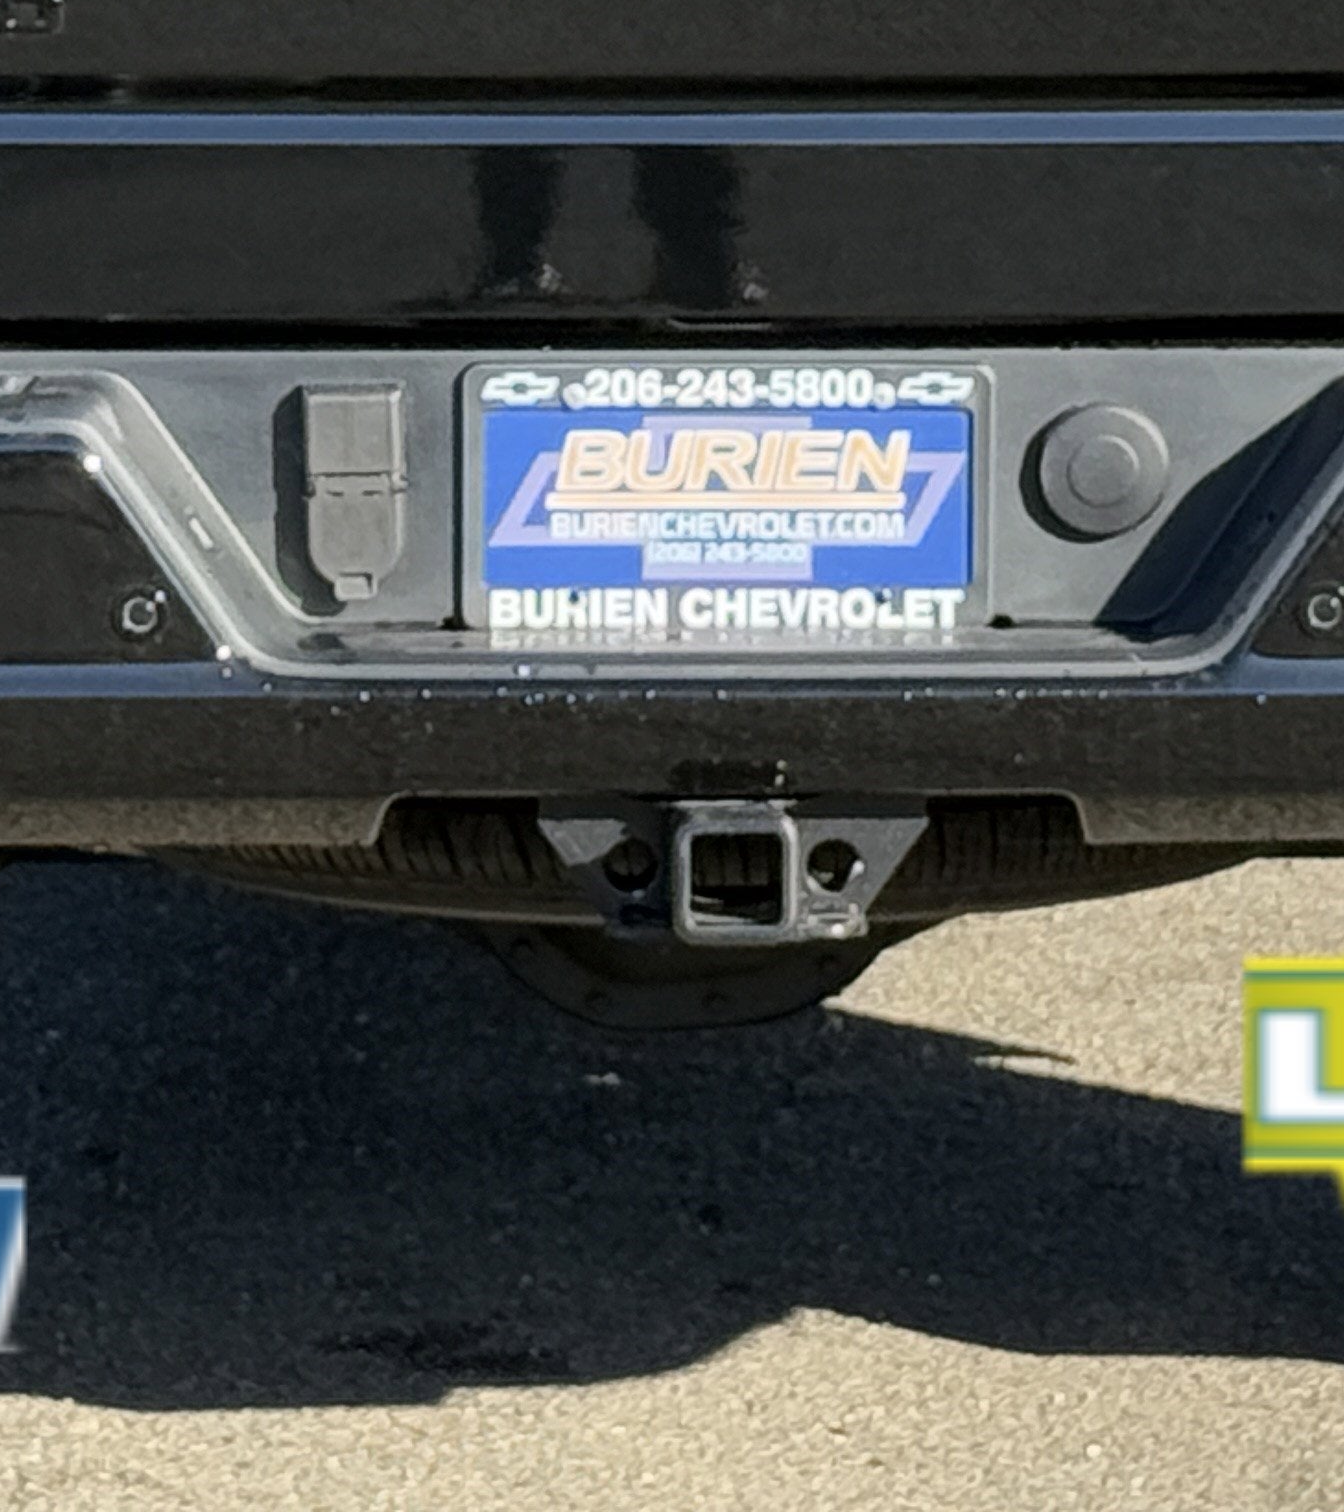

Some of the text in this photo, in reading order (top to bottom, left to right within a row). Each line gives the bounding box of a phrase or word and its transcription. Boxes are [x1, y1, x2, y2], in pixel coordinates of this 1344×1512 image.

[584, 369, 873, 408] 206-243-5800
[556, 429, 912, 492] BURIEN
[551, 512, 906, 539] BURIENCHEVROLET.COM
[488, 588, 965, 630] BURIEN CHEVROLET
